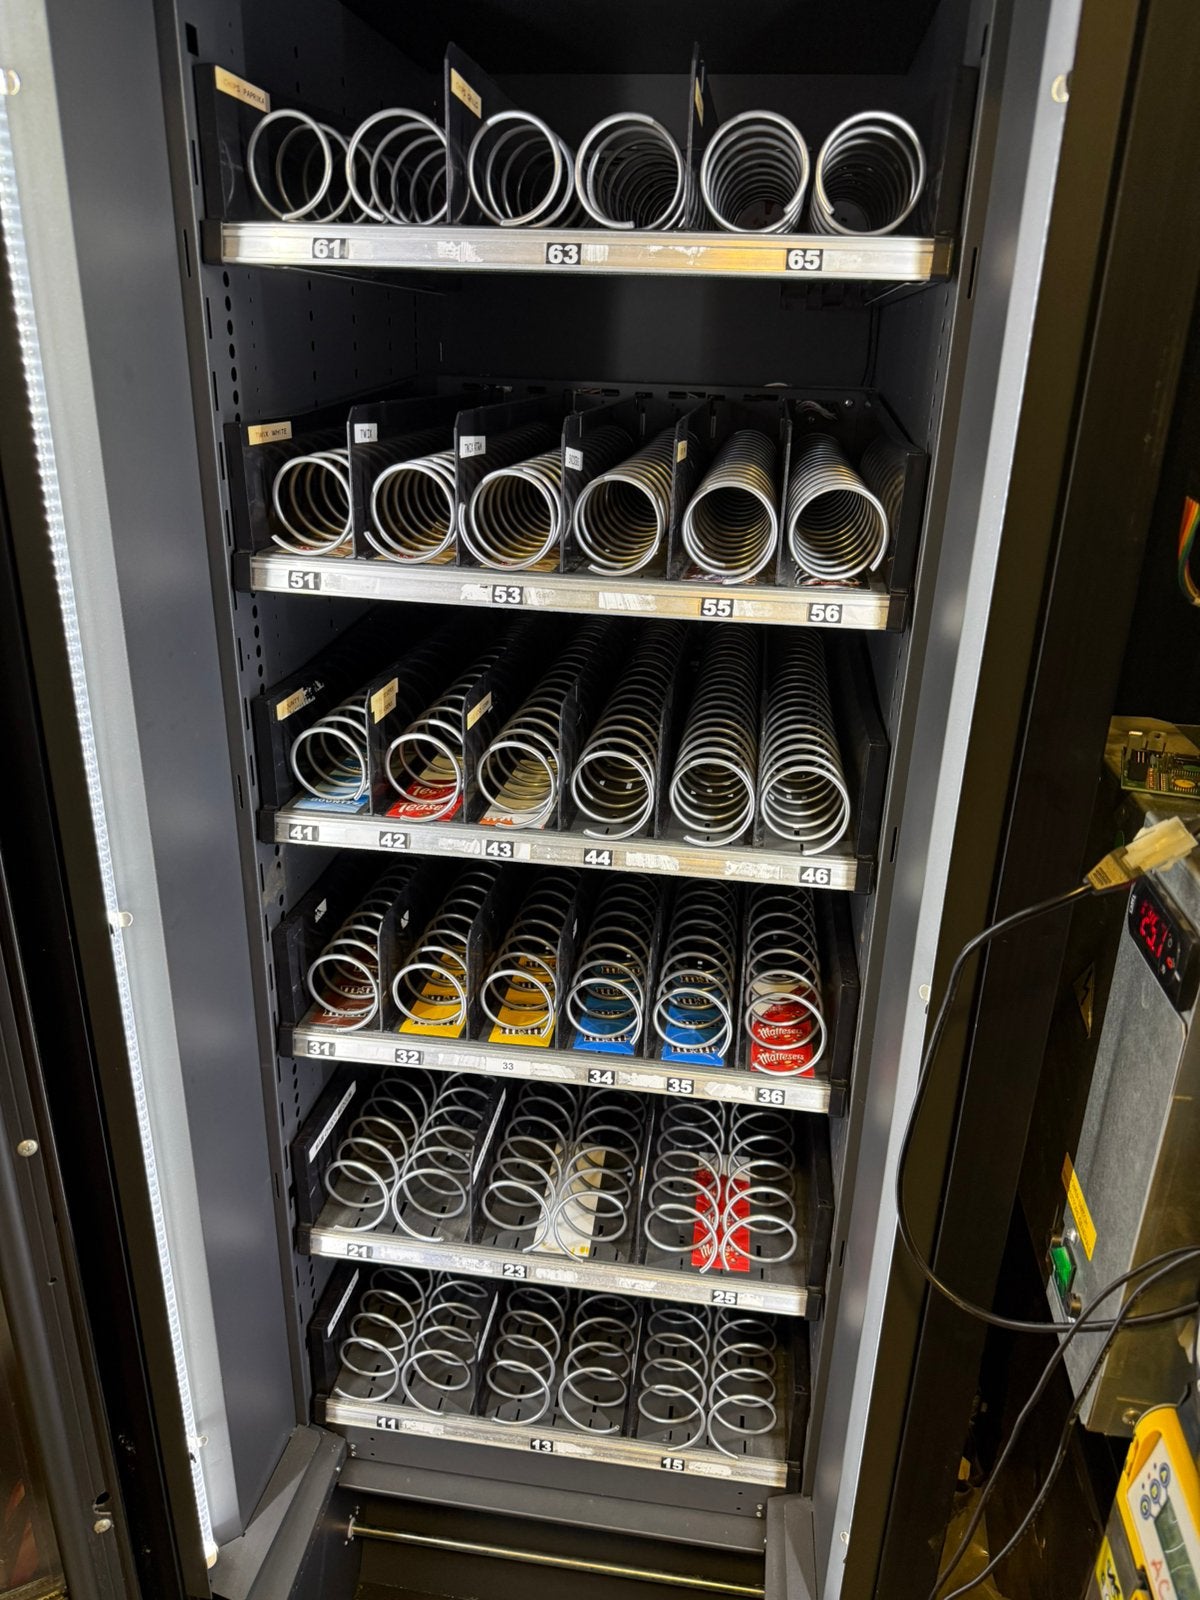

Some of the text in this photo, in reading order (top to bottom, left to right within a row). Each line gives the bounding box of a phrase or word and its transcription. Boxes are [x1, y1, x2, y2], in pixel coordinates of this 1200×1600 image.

[313, 239, 341, 258] 61
[548, 244, 578, 264] 63
[788, 249, 821, 270] 65
[290, 572, 315, 590] 51
[494, 586, 521, 604] 53
[703, 599, 731, 617] 55
[810, 604, 840, 623] 56
[290, 826, 313, 841] 41
[380, 832, 405, 847] 42
[487, 842, 511, 857] 43
[585, 850, 611, 865] 44
[802, 868, 828, 884] 46
[757, 1026, 803, 1039] Maltesers
[308, 1042, 331, 1055] 31
[397, 1051, 419, 1064] 32
[757, 1052, 805, 1066] Maltesers
[502, 1062, 514, 1070] 33
[590, 1070, 614, 1084] 34
[668, 1079, 692, 1093] 35
[759, 1090, 783, 1103] 36
[348, 1245, 368, 1257] 21
[504, 1264, 525, 1276] 23
[713, 1291, 736, 1303] 25
[378, 1418, 398, 1430] 11
[532, 1440, 552, 1452] 13
[663, 1459, 684, 1471] 15
